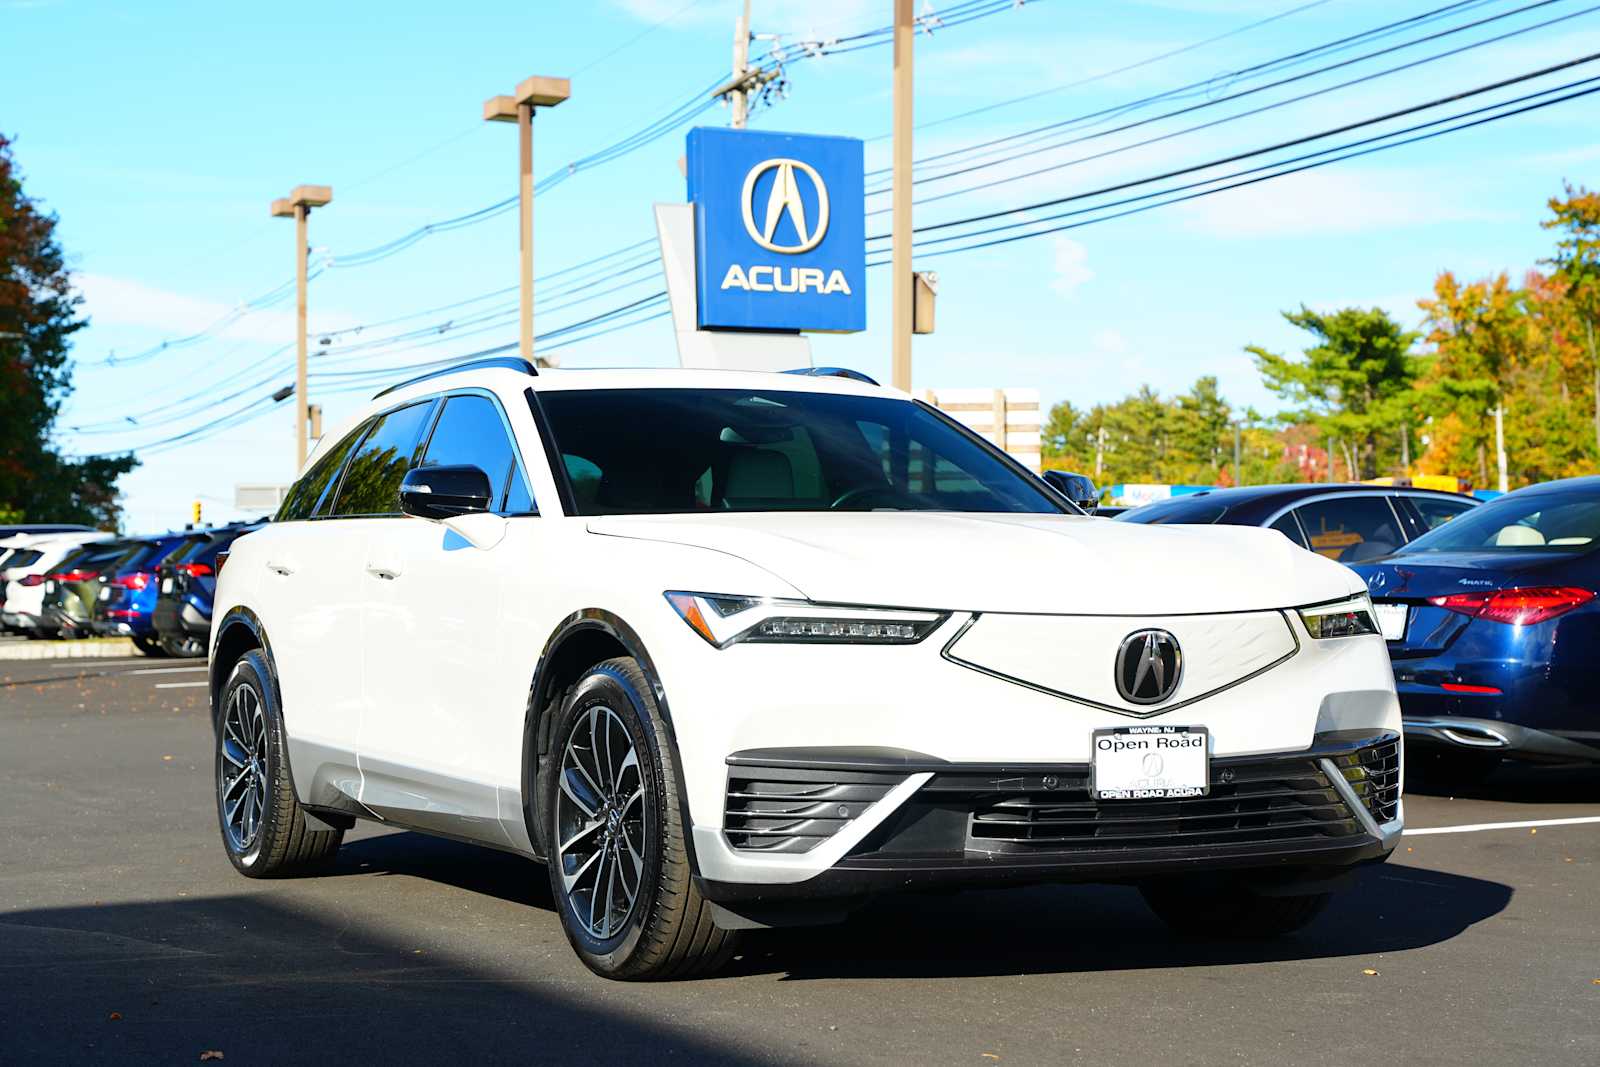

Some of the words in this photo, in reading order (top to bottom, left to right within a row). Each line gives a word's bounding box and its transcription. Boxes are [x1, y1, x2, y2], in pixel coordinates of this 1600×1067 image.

[721, 264, 852, 295] ACURA
[1098, 739, 1149, 752] Open
[1157, 736, 1202, 749] Road
[1100, 790, 1131, 799] OPEN
[1133, 789, 1164, 798] ROAD
[1166, 788, 1203, 797] ACURA
